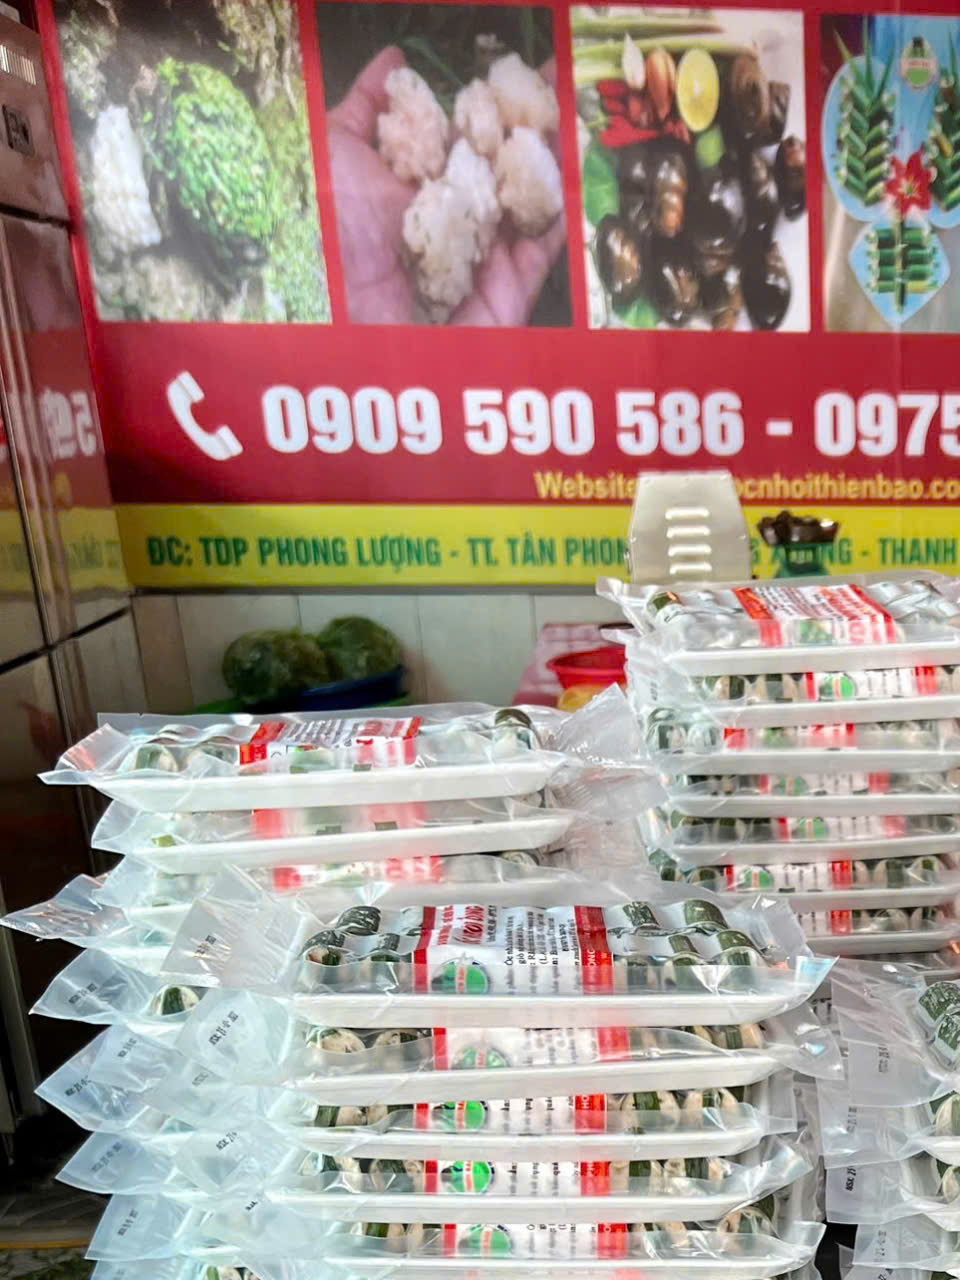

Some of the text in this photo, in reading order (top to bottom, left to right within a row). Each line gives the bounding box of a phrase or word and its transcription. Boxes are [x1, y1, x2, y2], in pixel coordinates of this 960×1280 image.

[262, 384, 443, 455] 0909
[462, 387, 596, 457] 590
[615, 389, 745, 457] 586
[766, 418, 793, 437] -
[258, 537, 350, 567] PHONG
[357, 534, 441, 574] LƯỢNG
[507, 530, 556, 567] TÂN
[564, 537, 629, 567] PHON
[878, 537, 960, 566] THANH
